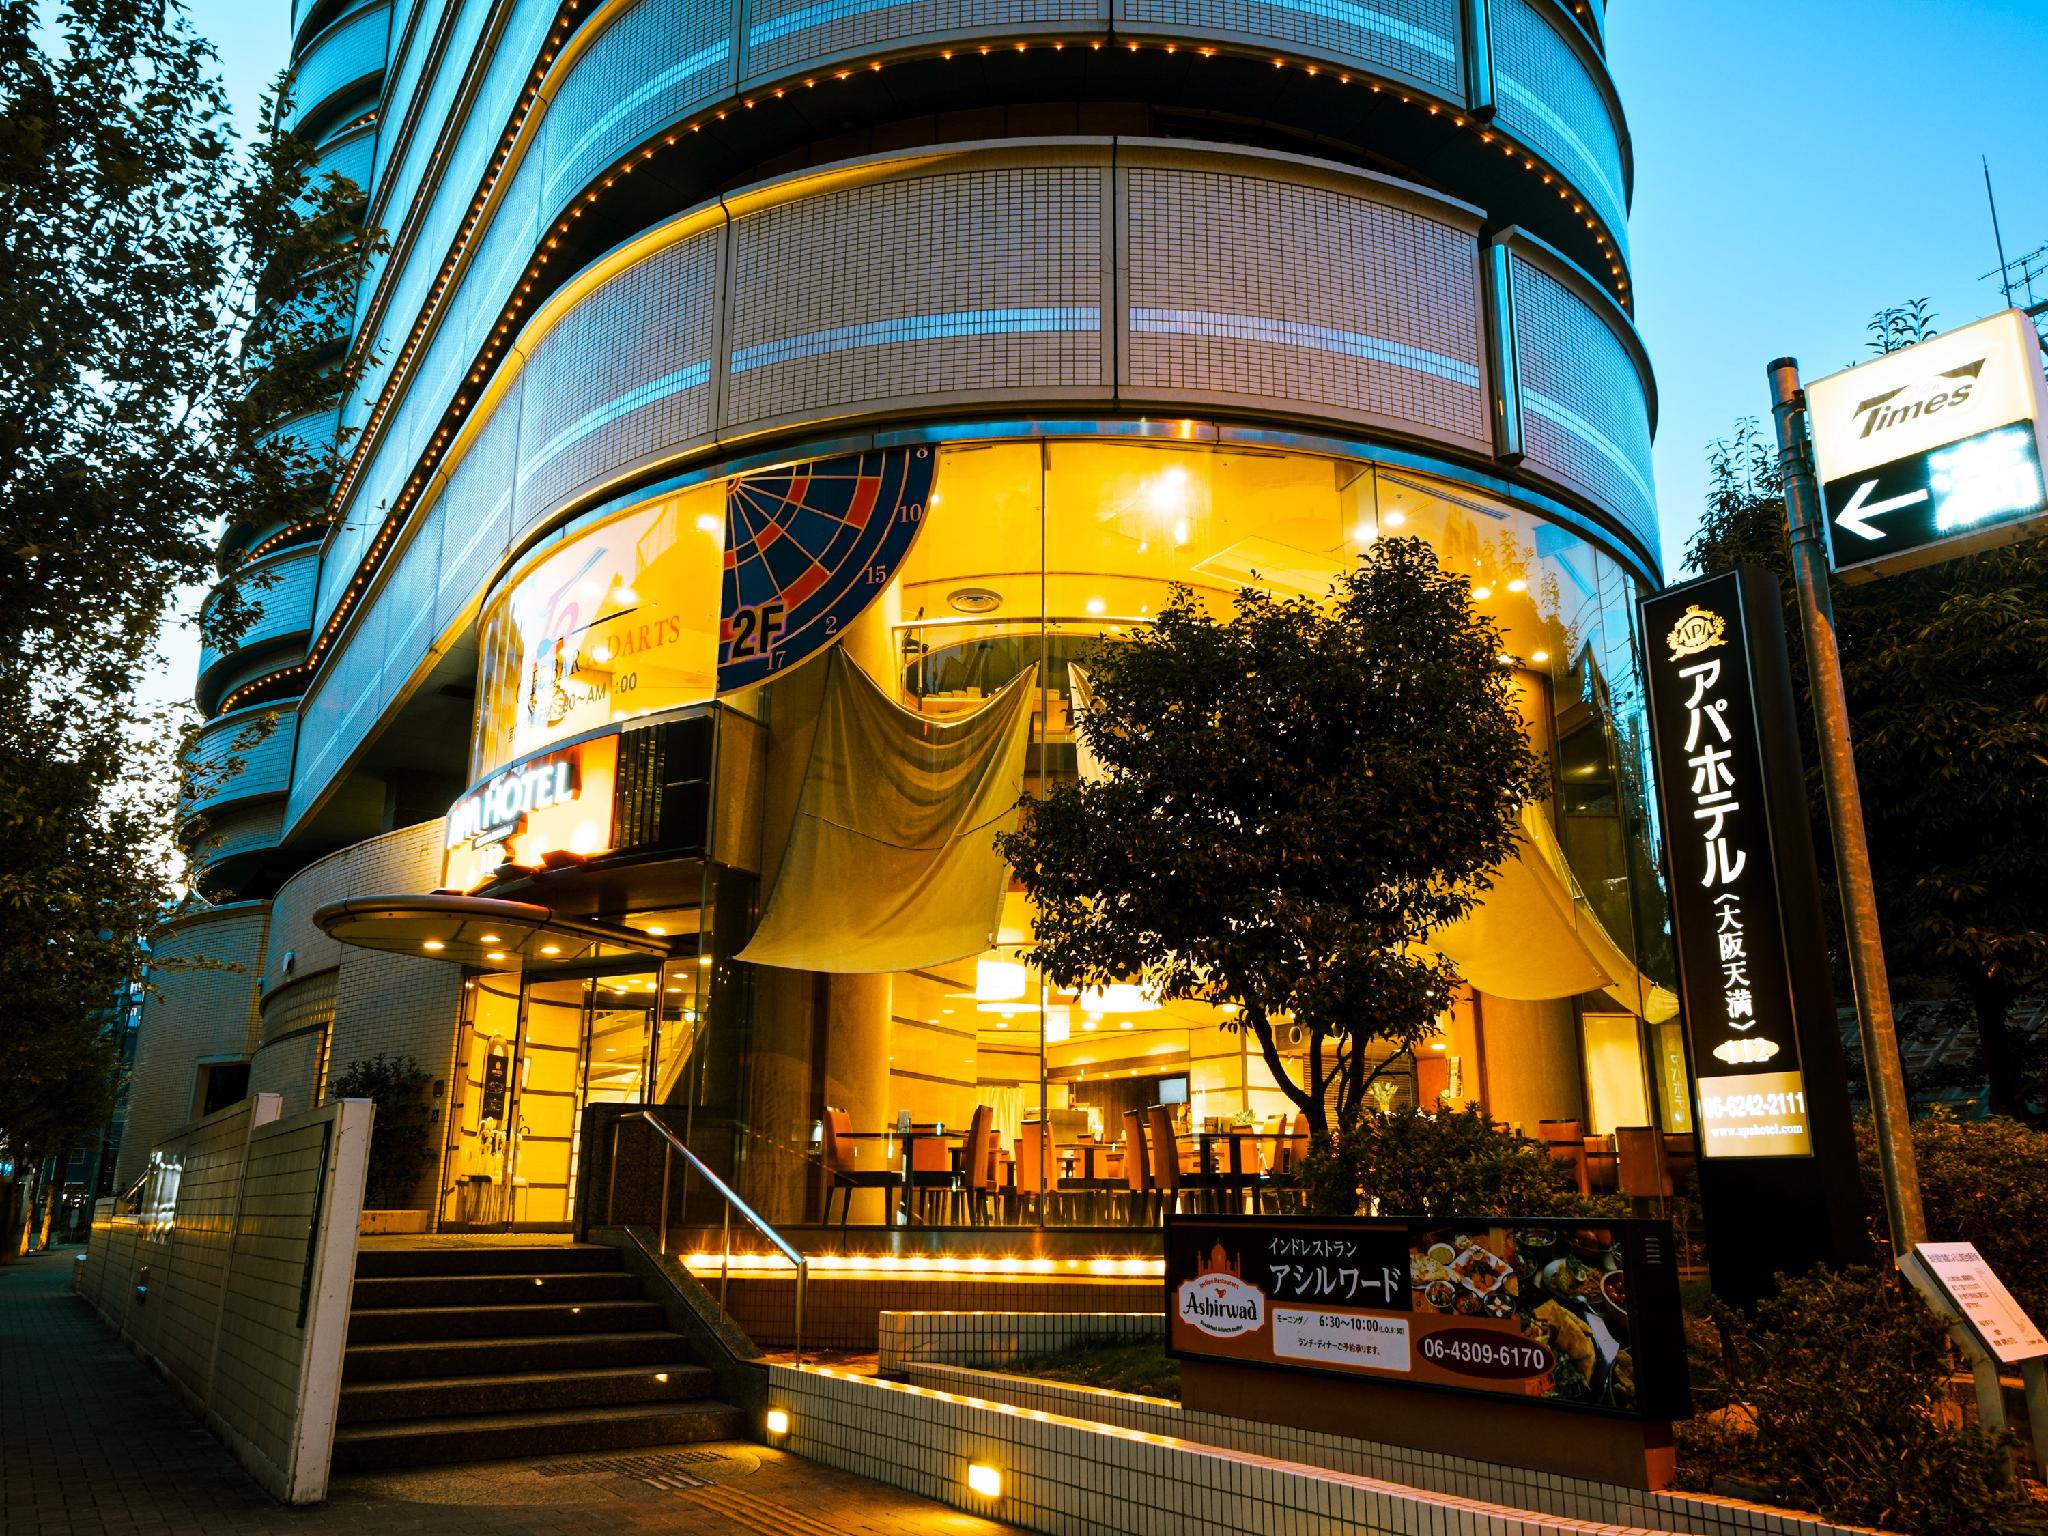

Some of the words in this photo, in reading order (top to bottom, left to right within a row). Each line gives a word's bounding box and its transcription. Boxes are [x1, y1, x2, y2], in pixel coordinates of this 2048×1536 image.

[1852, 358, 1986, 440] Times
[899, 503, 922, 523] 10
[865, 565, 887, 585] 15
[606, 615, 681, 661] DARTS
[732, 604, 785, 658] 2F
[825, 615, 837, 635] 2
[1678, 658, 1747, 888] アパホテル
[483, 762, 574, 830] HOTEL
[1703, 1092, 1805, 1120] 06-6242-2111
[1269, 1237, 1358, 1258] インドレストラン
[1269, 1264, 1401, 1303] アシルワード
[1183, 1291, 1258, 1321] Ashirwad
[1424, 1338, 1545, 1370] 06-4309-6170
